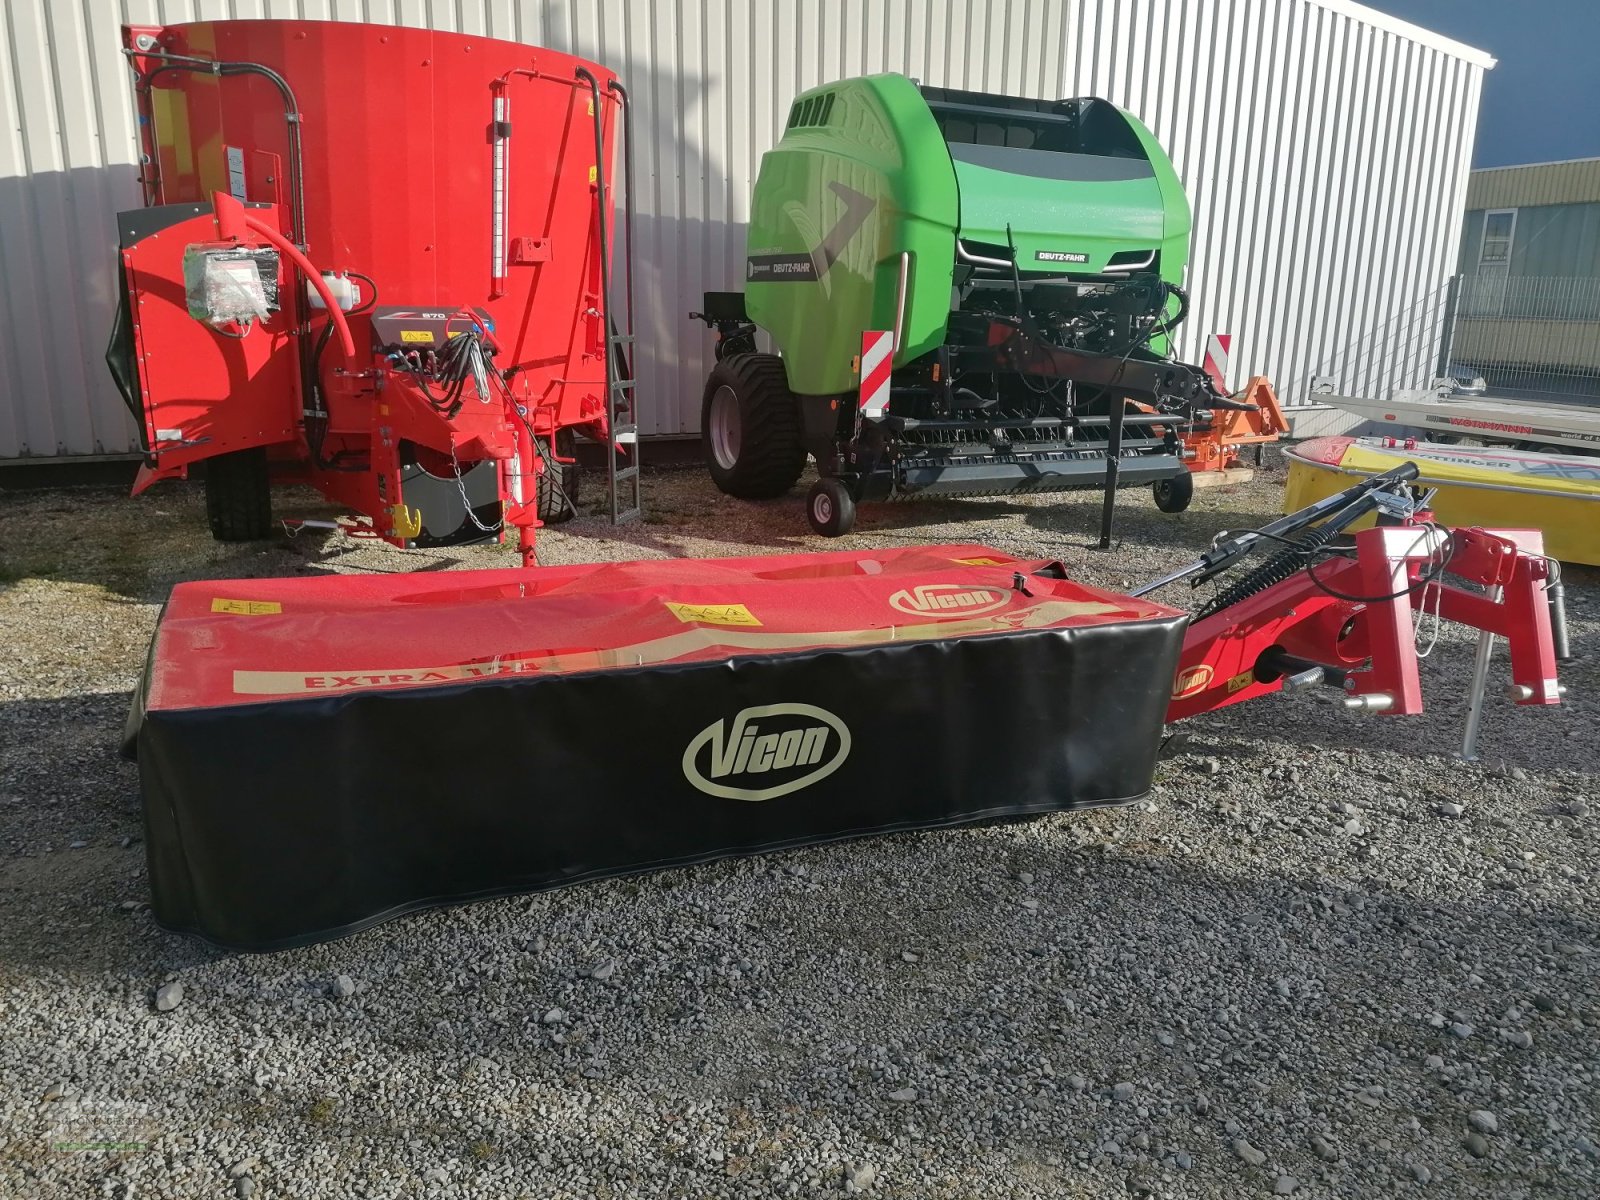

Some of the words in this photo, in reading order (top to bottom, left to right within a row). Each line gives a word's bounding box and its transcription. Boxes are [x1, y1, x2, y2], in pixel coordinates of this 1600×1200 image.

[1039, 252, 1086, 262] DEUTZ-FAHR
[773, 263, 810, 273] DEUTZ-FAHR
[902, 586, 995, 611] Vicon
[304, 671, 450, 689] EXTRA
[1173, 669, 1208, 696] Vicon
[705, 706, 834, 782] Vicon
